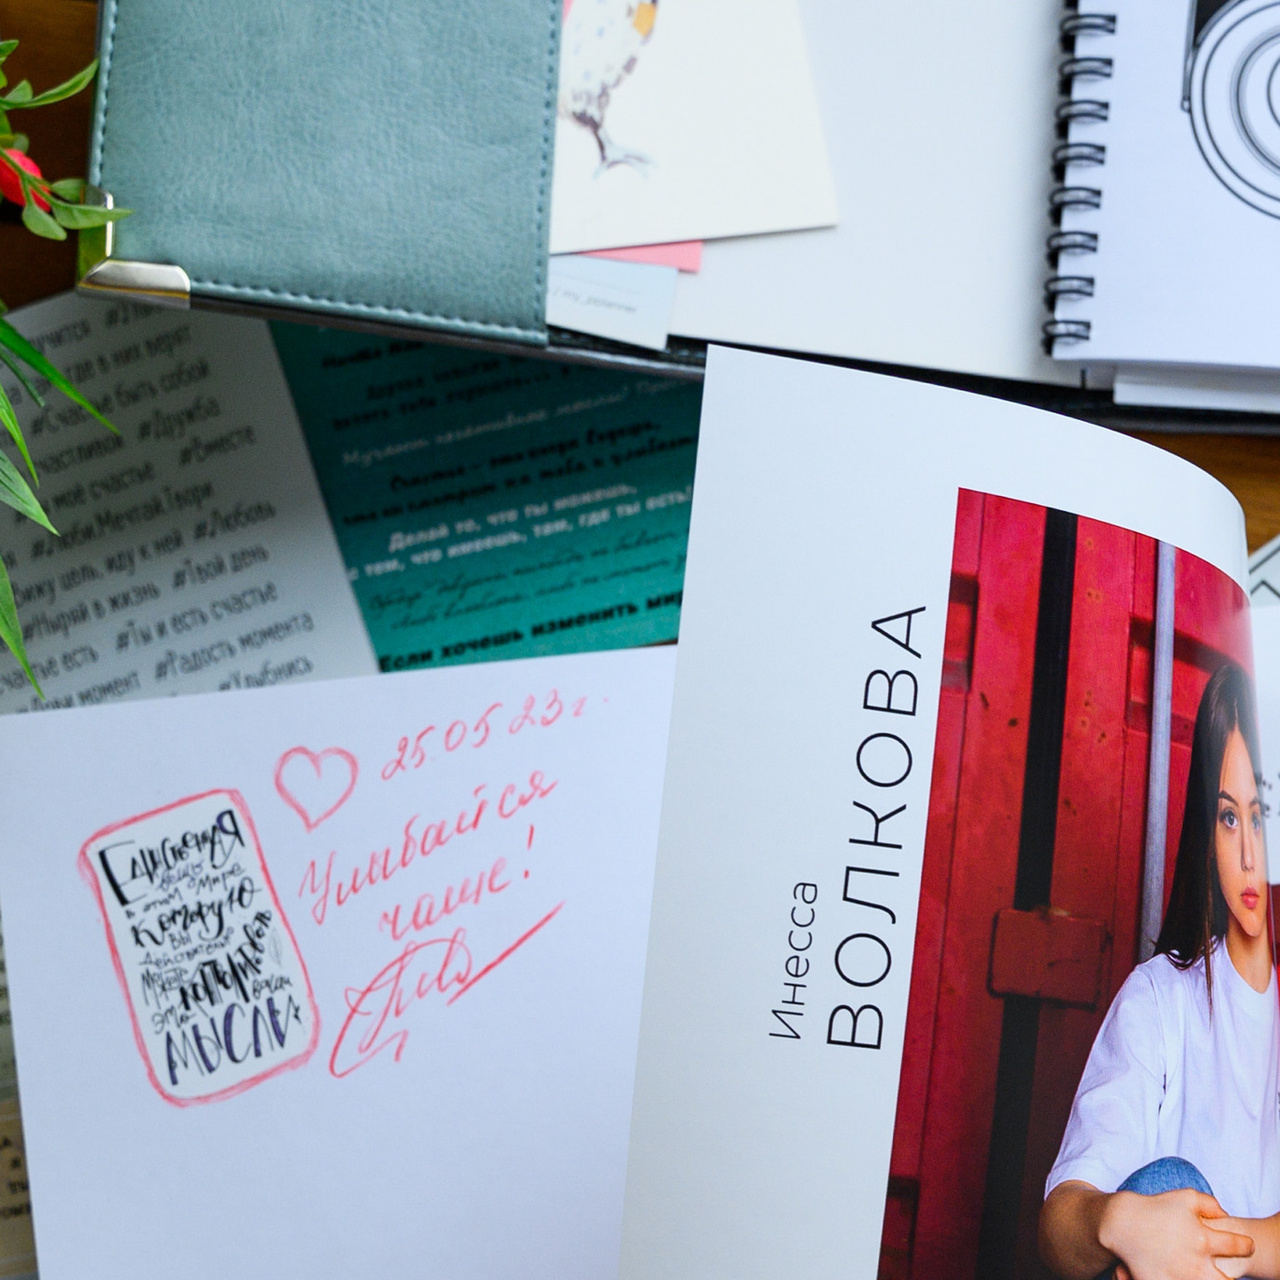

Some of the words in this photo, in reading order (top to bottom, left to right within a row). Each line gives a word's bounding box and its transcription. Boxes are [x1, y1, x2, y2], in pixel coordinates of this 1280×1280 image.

[389, 522, 450, 553] Делай
[379, 650, 434, 674] Если
[442, 628, 525, 660] хочешь
[531, 602, 639, 638] изменить
[826, 605, 927, 1050] ВОЛКОВА
[768, 881, 818, 1040] Инесса
